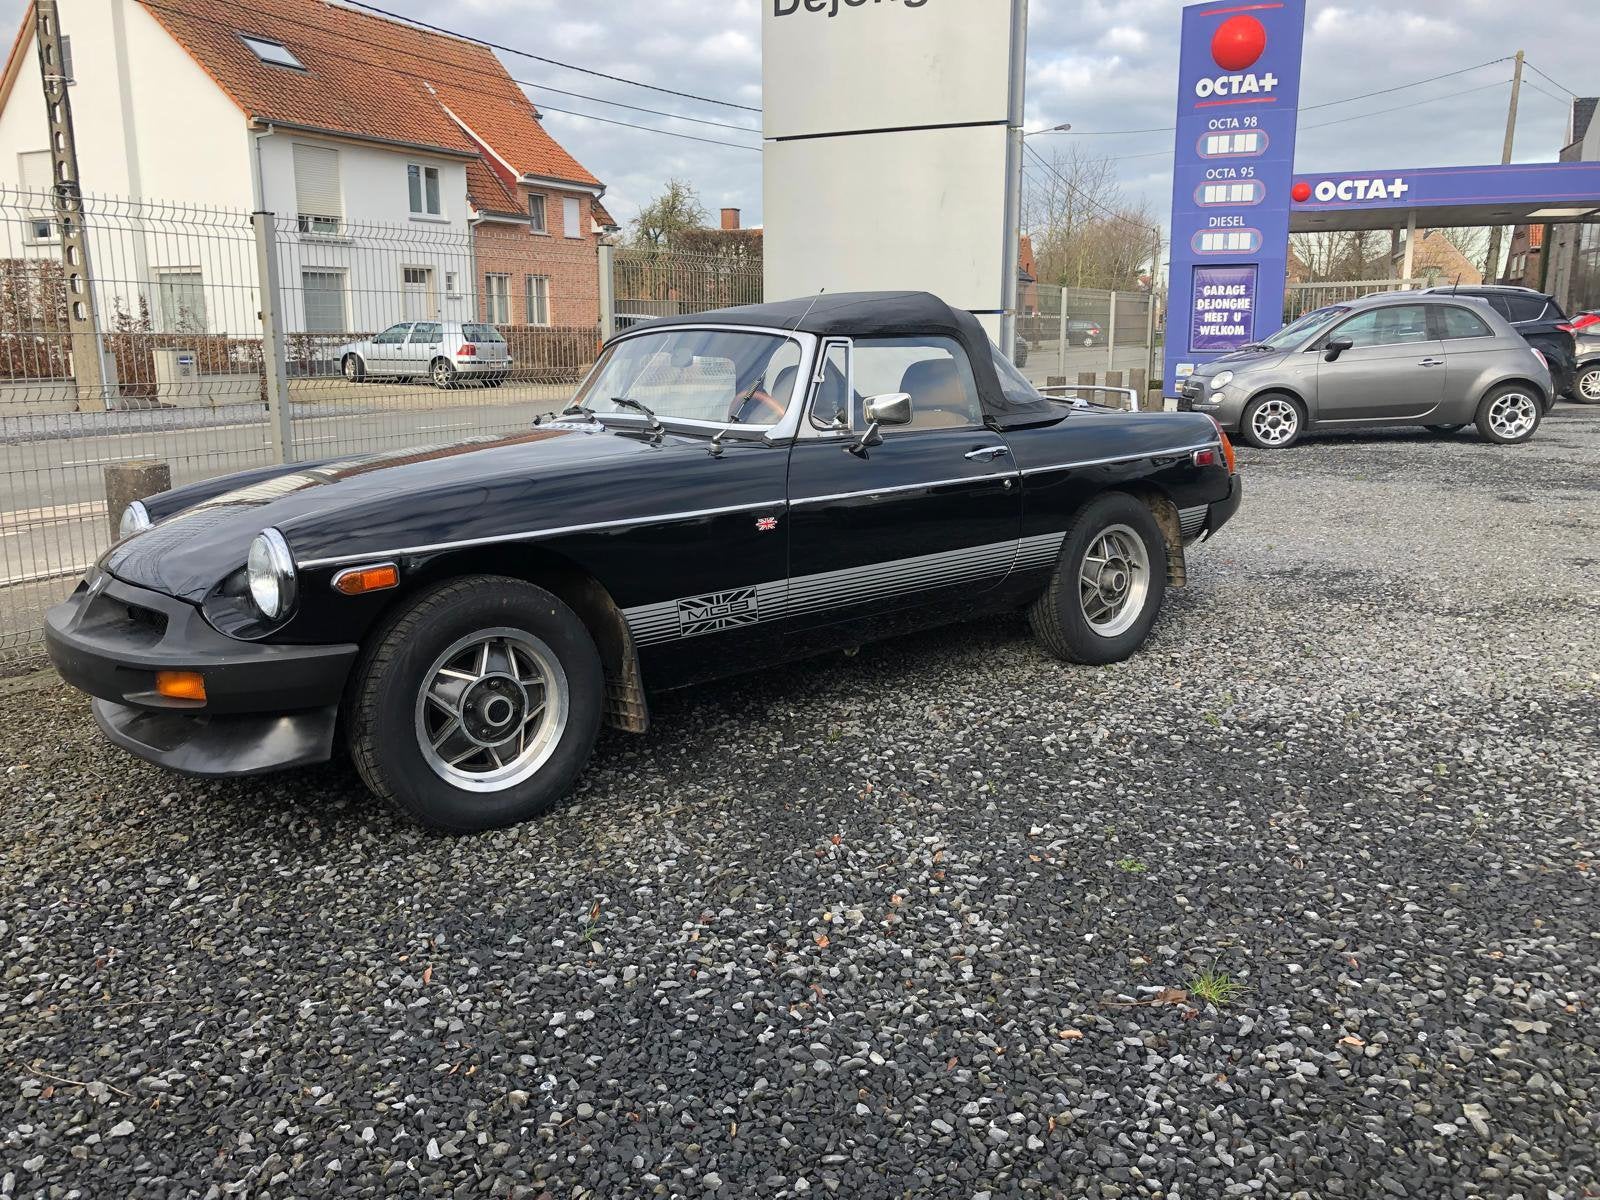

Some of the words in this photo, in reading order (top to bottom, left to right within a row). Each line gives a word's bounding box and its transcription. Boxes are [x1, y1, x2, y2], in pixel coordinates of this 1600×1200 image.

[1195, 72, 1278, 98] OCTA+
[1208, 118, 1240, 130] OCTA
[1243, 116, 1258, 128] 98
[1206, 168, 1237, 179] OCTA
[1240, 166, 1254, 177] 95
[1315, 178, 1408, 202] OCTA+
[1208, 216, 1245, 227] DIESEL
[1203, 284, 1246, 297] GARAGE
[1197, 297, 1251, 310] DEJONGHE
[1204, 312, 1228, 322] HEET
[1233, 312, 1242, 322] U
[1200, 325, 1245, 336] WELKOM
[687, 600, 750, 621] MGB
